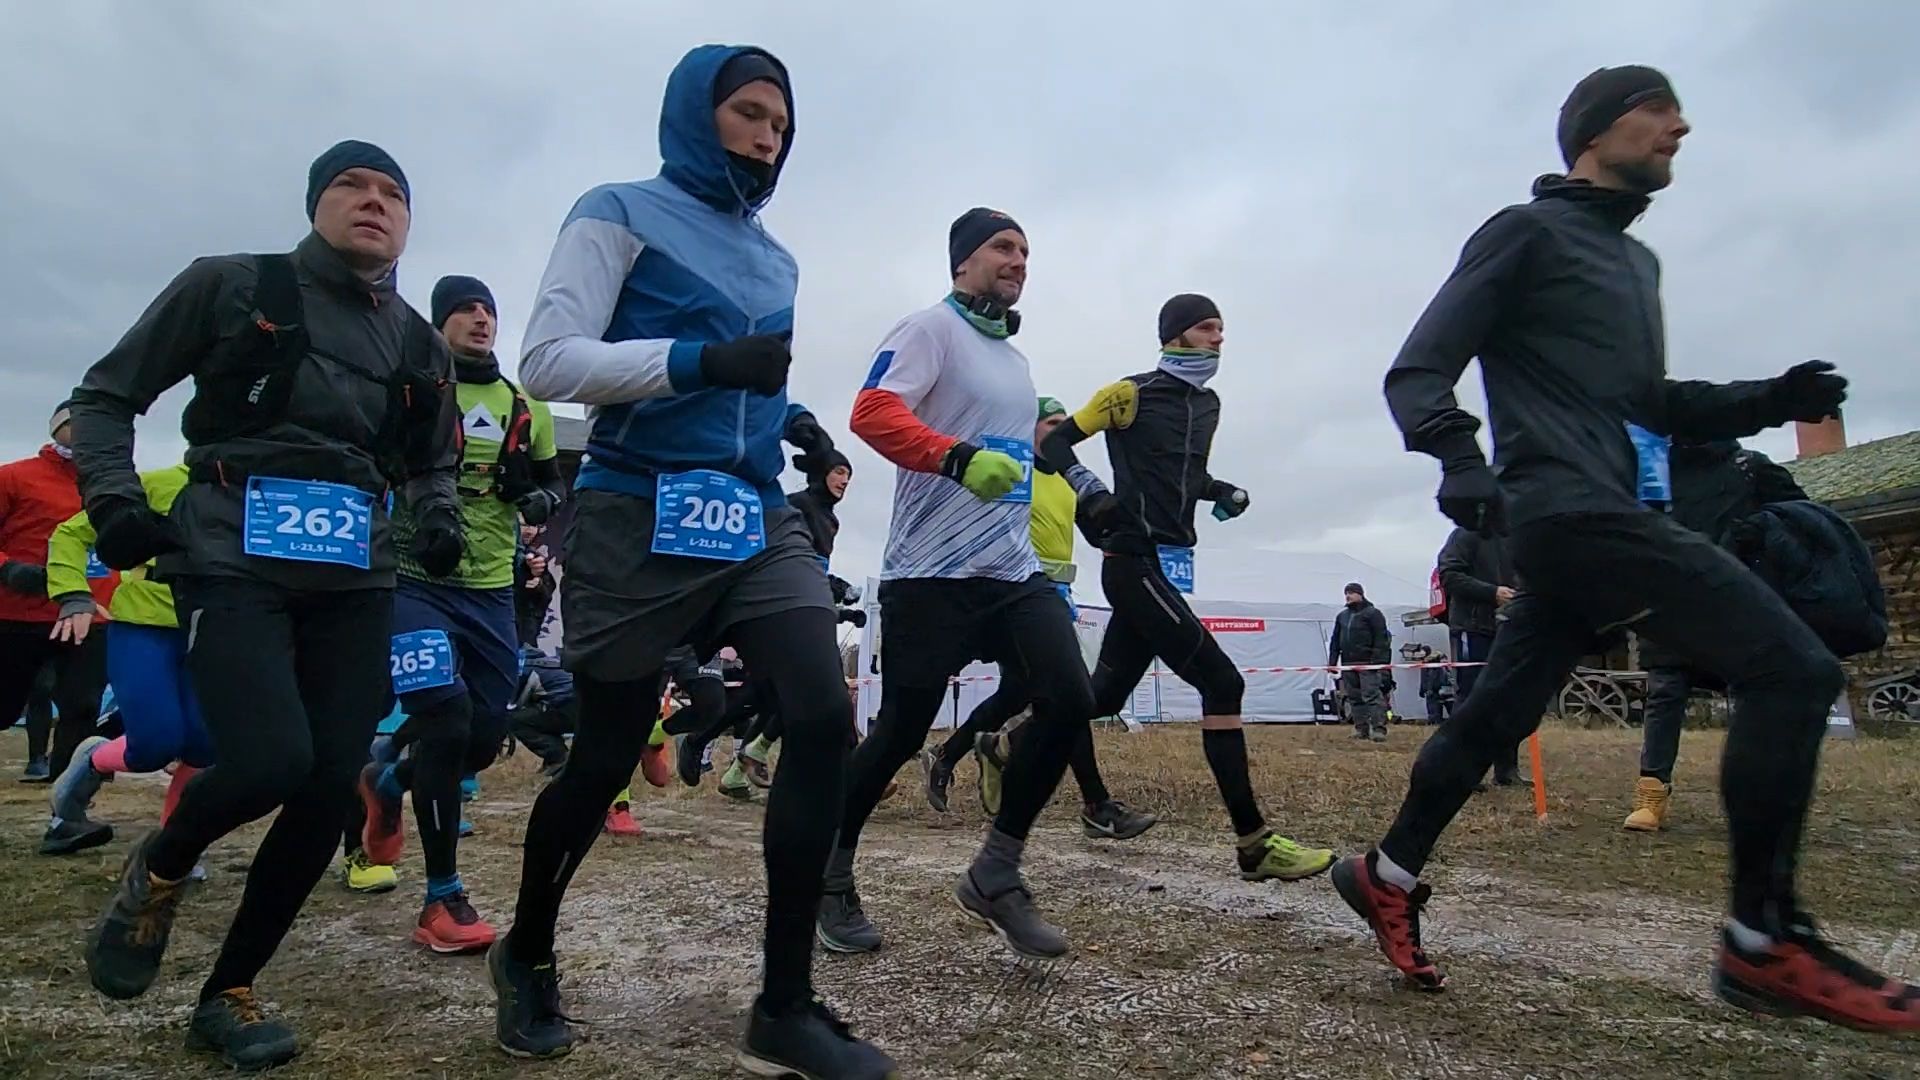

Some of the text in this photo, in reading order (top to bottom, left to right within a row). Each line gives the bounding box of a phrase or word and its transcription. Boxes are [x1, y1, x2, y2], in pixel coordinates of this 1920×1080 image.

[276, 505, 355, 540] 262
[680, 496, 747, 534] 208
[1167, 561, 1193, 580] 241
[390, 648, 436, 676] 265
